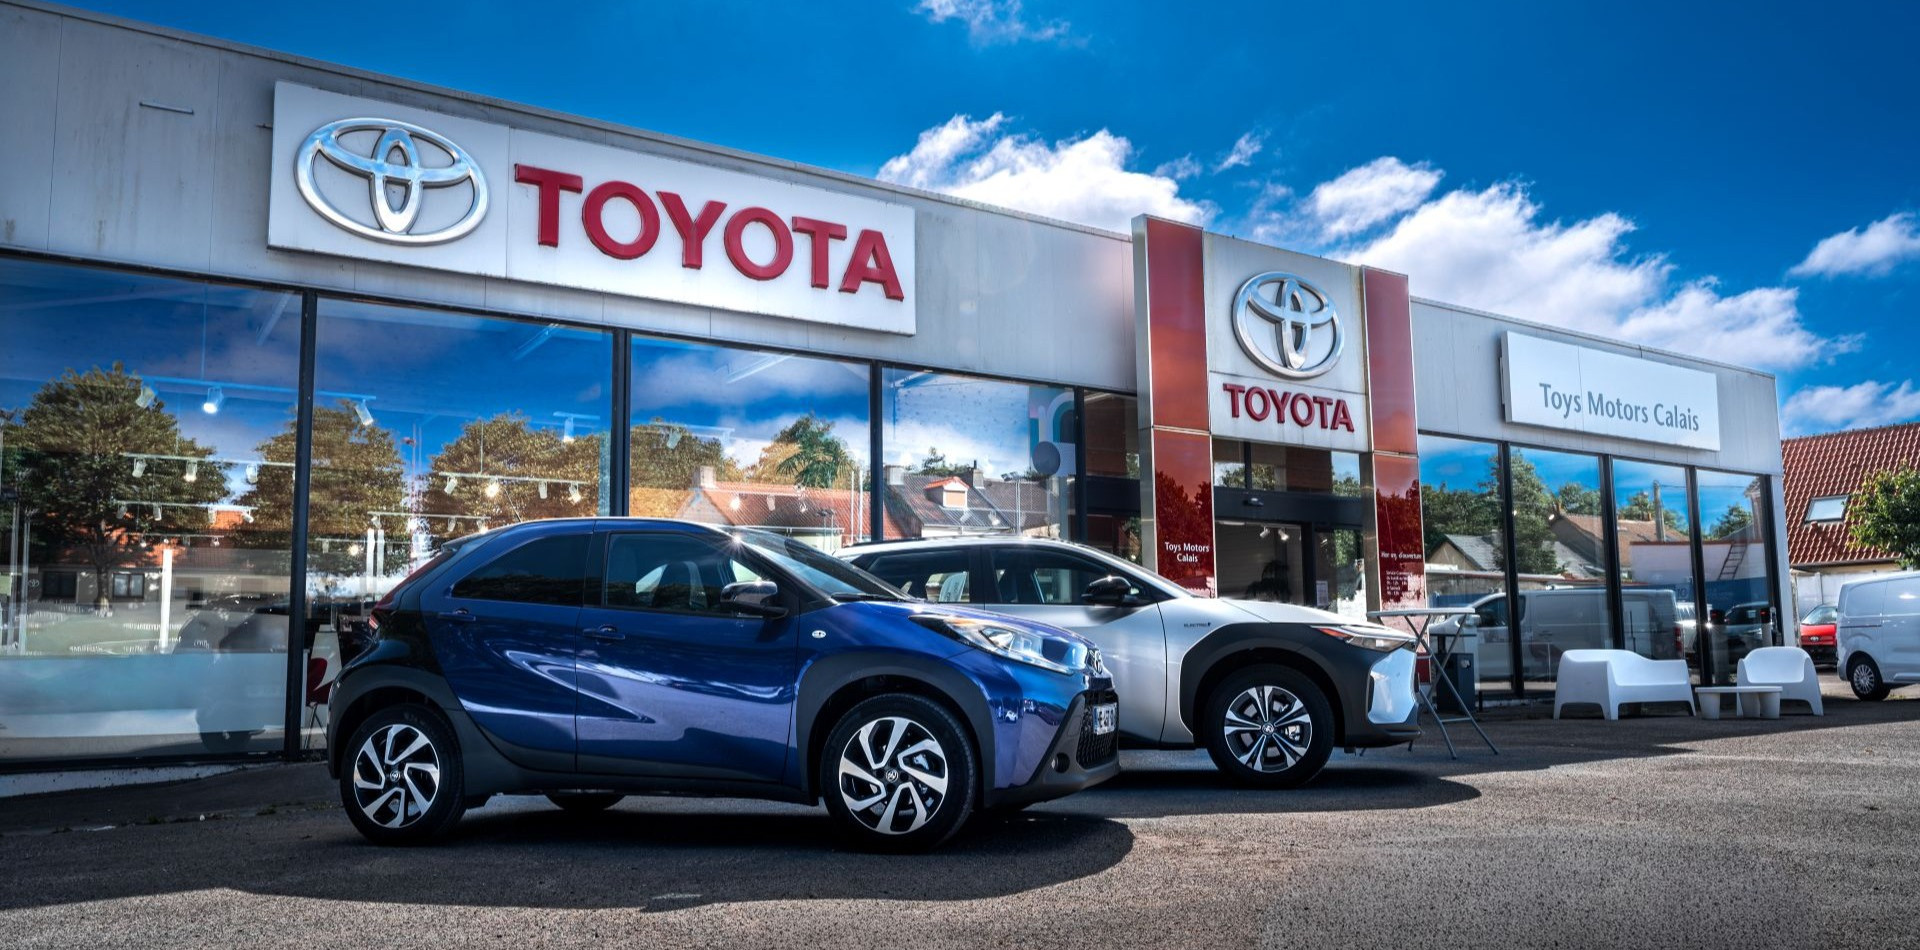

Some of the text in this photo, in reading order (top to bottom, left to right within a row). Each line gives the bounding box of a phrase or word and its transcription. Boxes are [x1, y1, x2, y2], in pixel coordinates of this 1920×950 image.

[514, 163, 904, 301] TOYOTA
[1223, 383, 1354, 432] TOYOTA
[1539, 383, 1699, 432] Toys Motors Calais
[1165, 542, 1209, 553] Toys Motors
[1176, 553, 1198, 562] Calais
